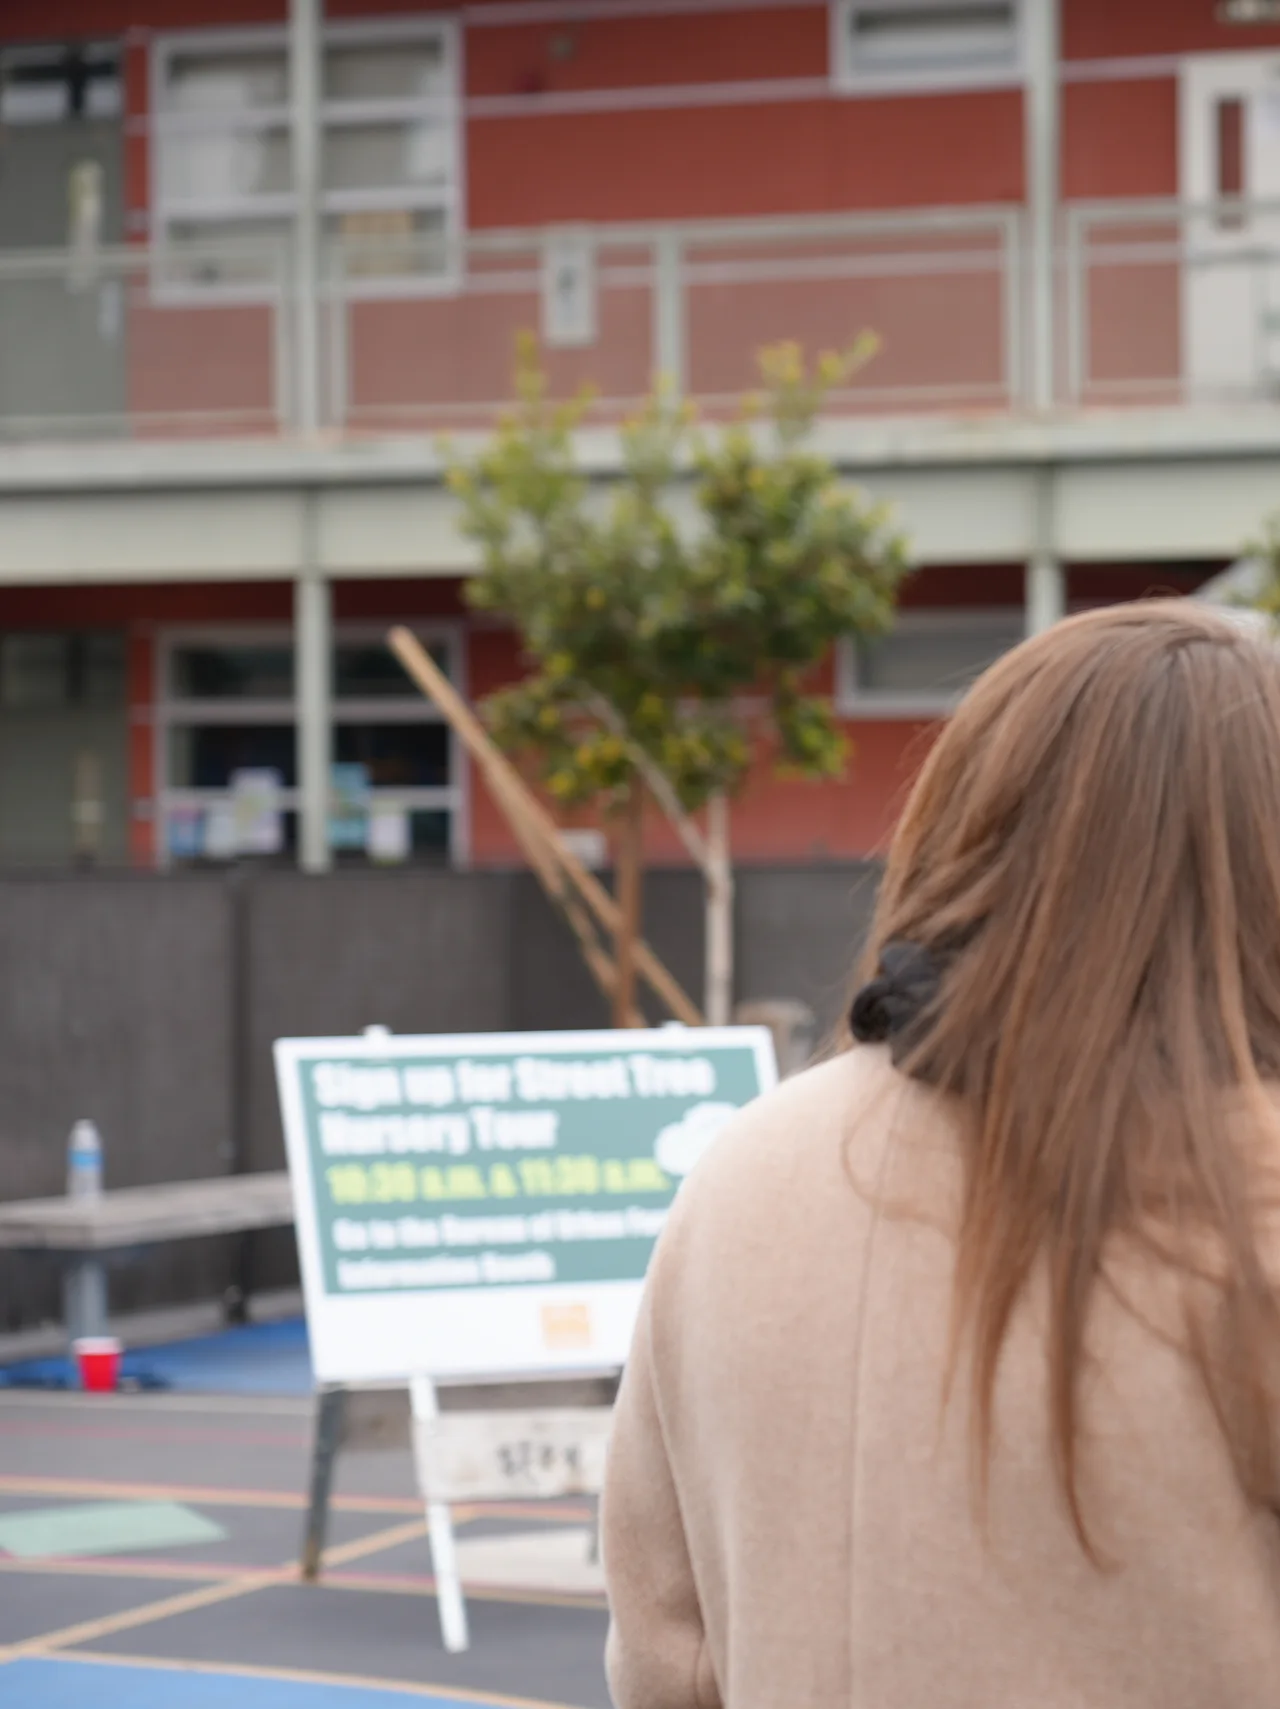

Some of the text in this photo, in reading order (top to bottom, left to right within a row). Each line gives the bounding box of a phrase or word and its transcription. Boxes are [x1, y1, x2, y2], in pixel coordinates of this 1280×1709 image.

[314, 1055, 715, 1108] Sign up for Street Tree
[319, 1107, 558, 1154] Nursery Tour
